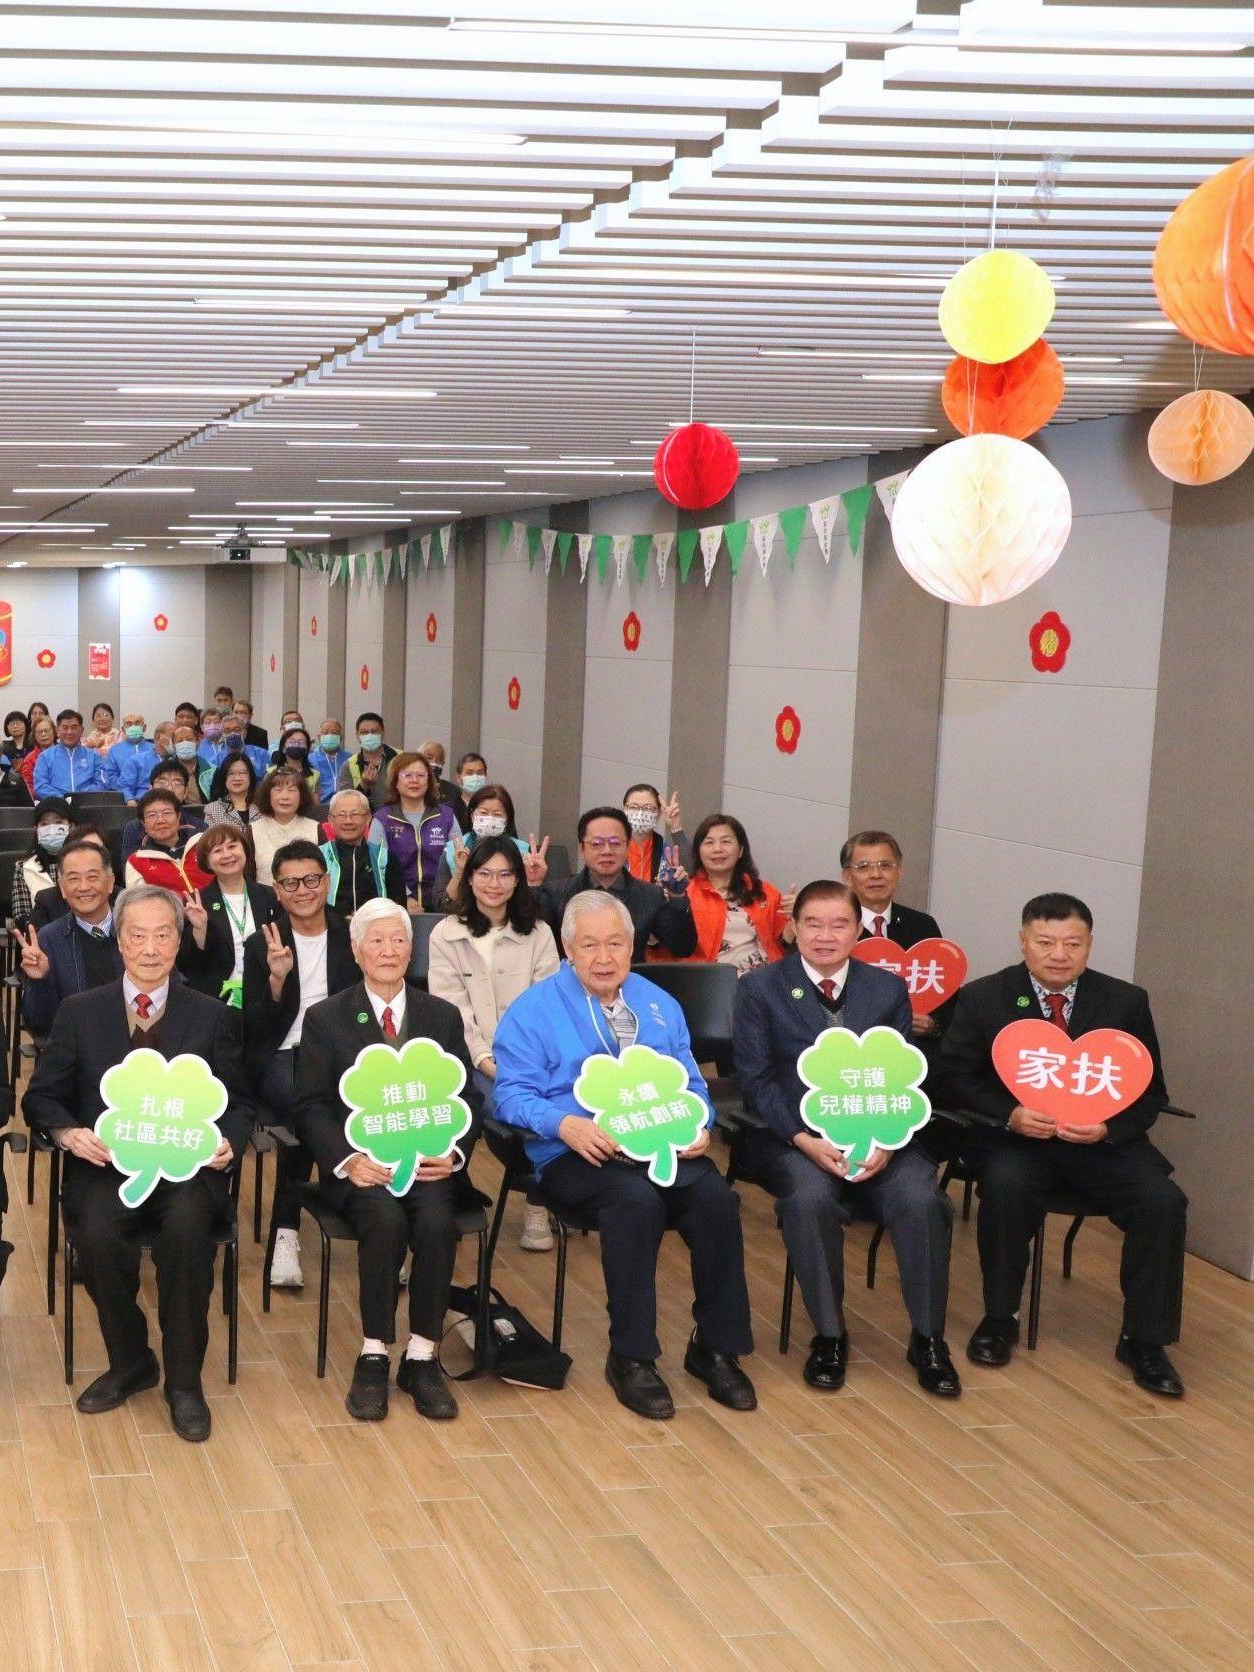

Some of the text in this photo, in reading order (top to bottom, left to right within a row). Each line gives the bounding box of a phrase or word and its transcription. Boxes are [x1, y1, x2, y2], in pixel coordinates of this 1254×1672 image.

[839, 1067, 887, 1089] 守護
[1015, 1046, 1124, 1101] 家扶
[140, 1094, 185, 1120] 扎根
[381, 1080, 427, 1106] 推動
[818, 1093, 913, 1117] 兒權精神
[362, 1103, 453, 1136] 智能學習
[608, 1100, 693, 1135] 領航創新
[113, 1119, 205, 1151] 社區共好
